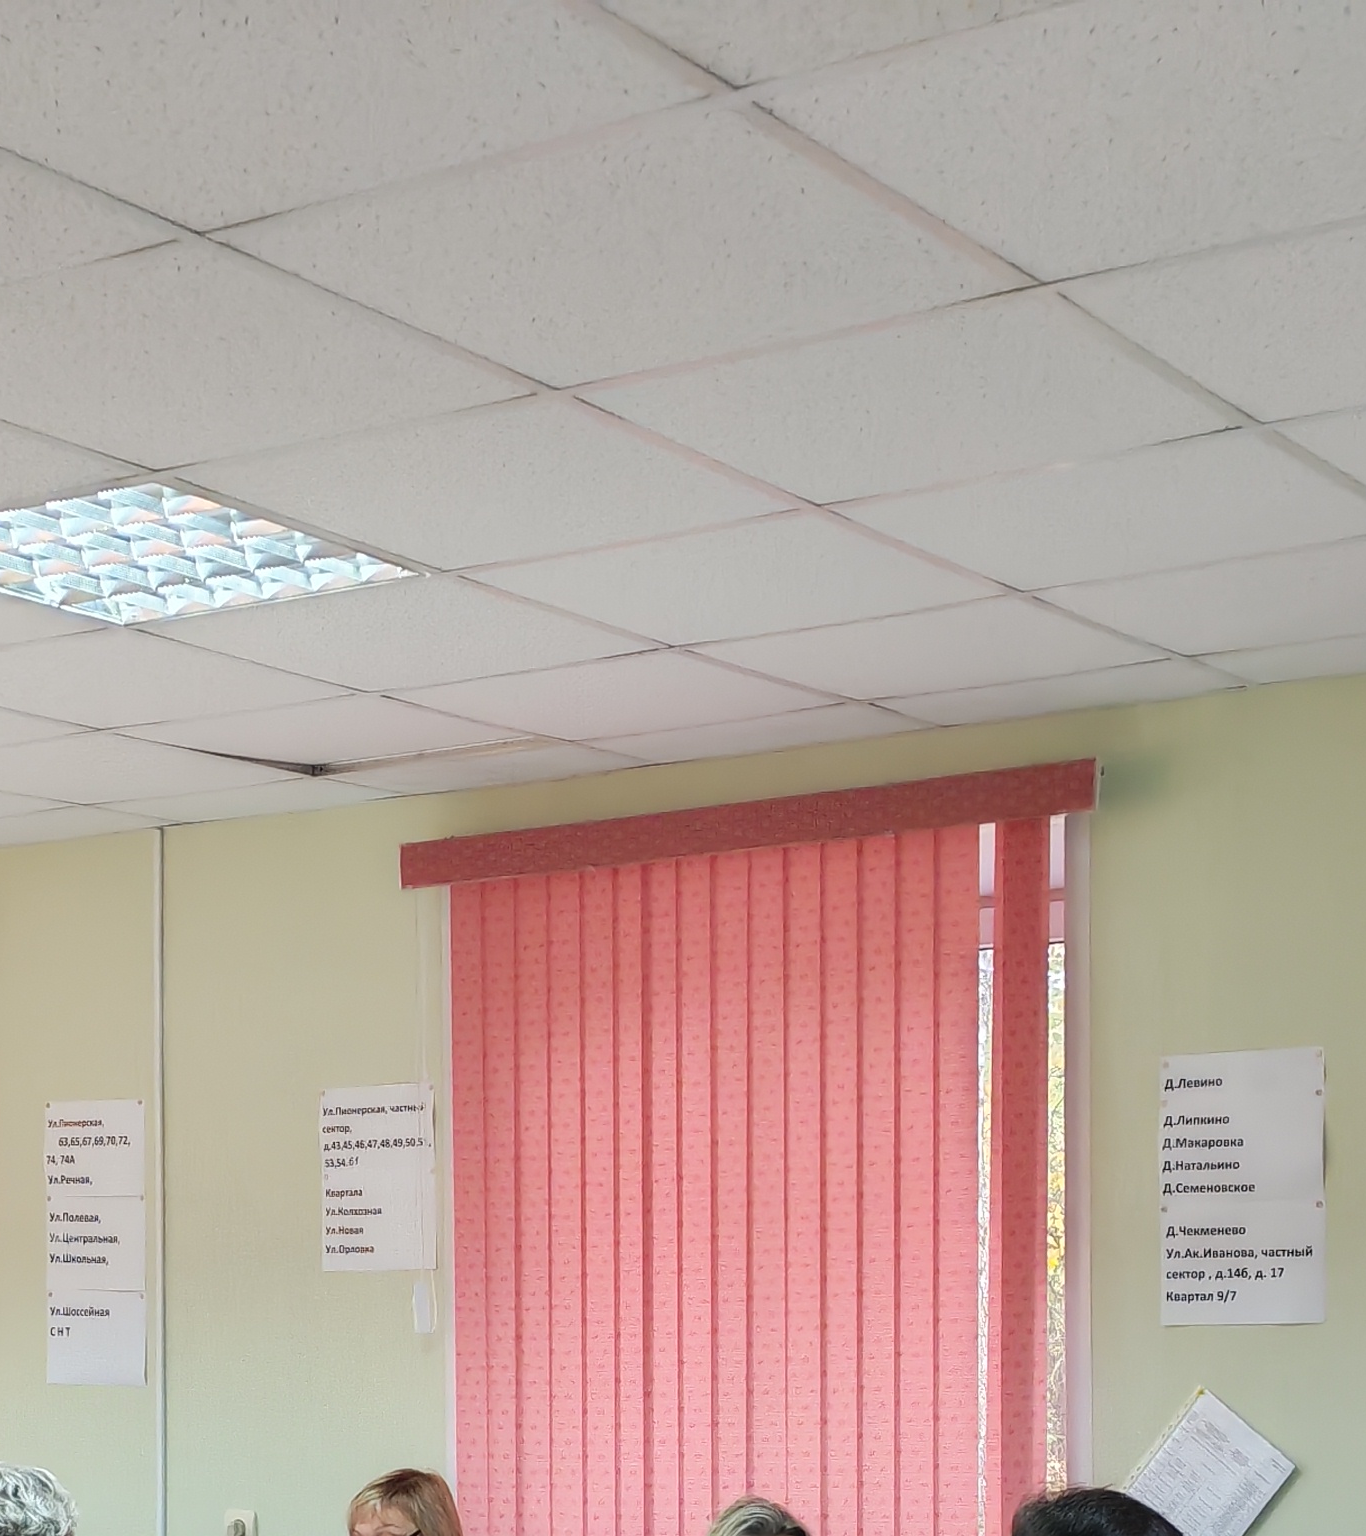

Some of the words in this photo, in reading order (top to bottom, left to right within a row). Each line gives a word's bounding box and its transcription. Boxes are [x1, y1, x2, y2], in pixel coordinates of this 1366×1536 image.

[1164, 1077, 1223, 1092] Д.Левино
[1163, 1115, 1230, 1128] Д.Липкино
[58, 1135, 131, 1148] 63,65,67,69,70,72,
[1162, 1137, 1244, 1151] Д.Макаровка
[46, 1155, 58, 1166] 74,
[1162, 1160, 1241, 1173] Д.Натальино
[47, 1174, 93, 1186] Ул.Речная,
[325, 1189, 363, 1200] Квартала
[1162, 1183, 1256, 1196] Д.Семеновское
[49, 1212, 101, 1224] Ул.Полевая,
[325, 1207, 382, 1217] Ул.Колхозная
[325, 1226, 364, 1235] Ул.Новая
[1166, 1226, 1246, 1239] Д.Чекменево
[49, 1232, 120, 1245] Ул.Центральная,
[325, 1245, 375, 1255] Ул.Орловка
[1166, 1247, 1258, 1259] Ул.Ак.Иванова,
[1261, 1245, 1313, 1258] частный
[49, 1253, 109, 1266] Ул.Школьная,
[1270, 1267, 1285, 1278] 17
[1166, 1291, 1214, 1304] Квартал
[1217, 1290, 1237, 1303] 9/7
[49, 1306, 110, 1317] Ул.Шоссейная
